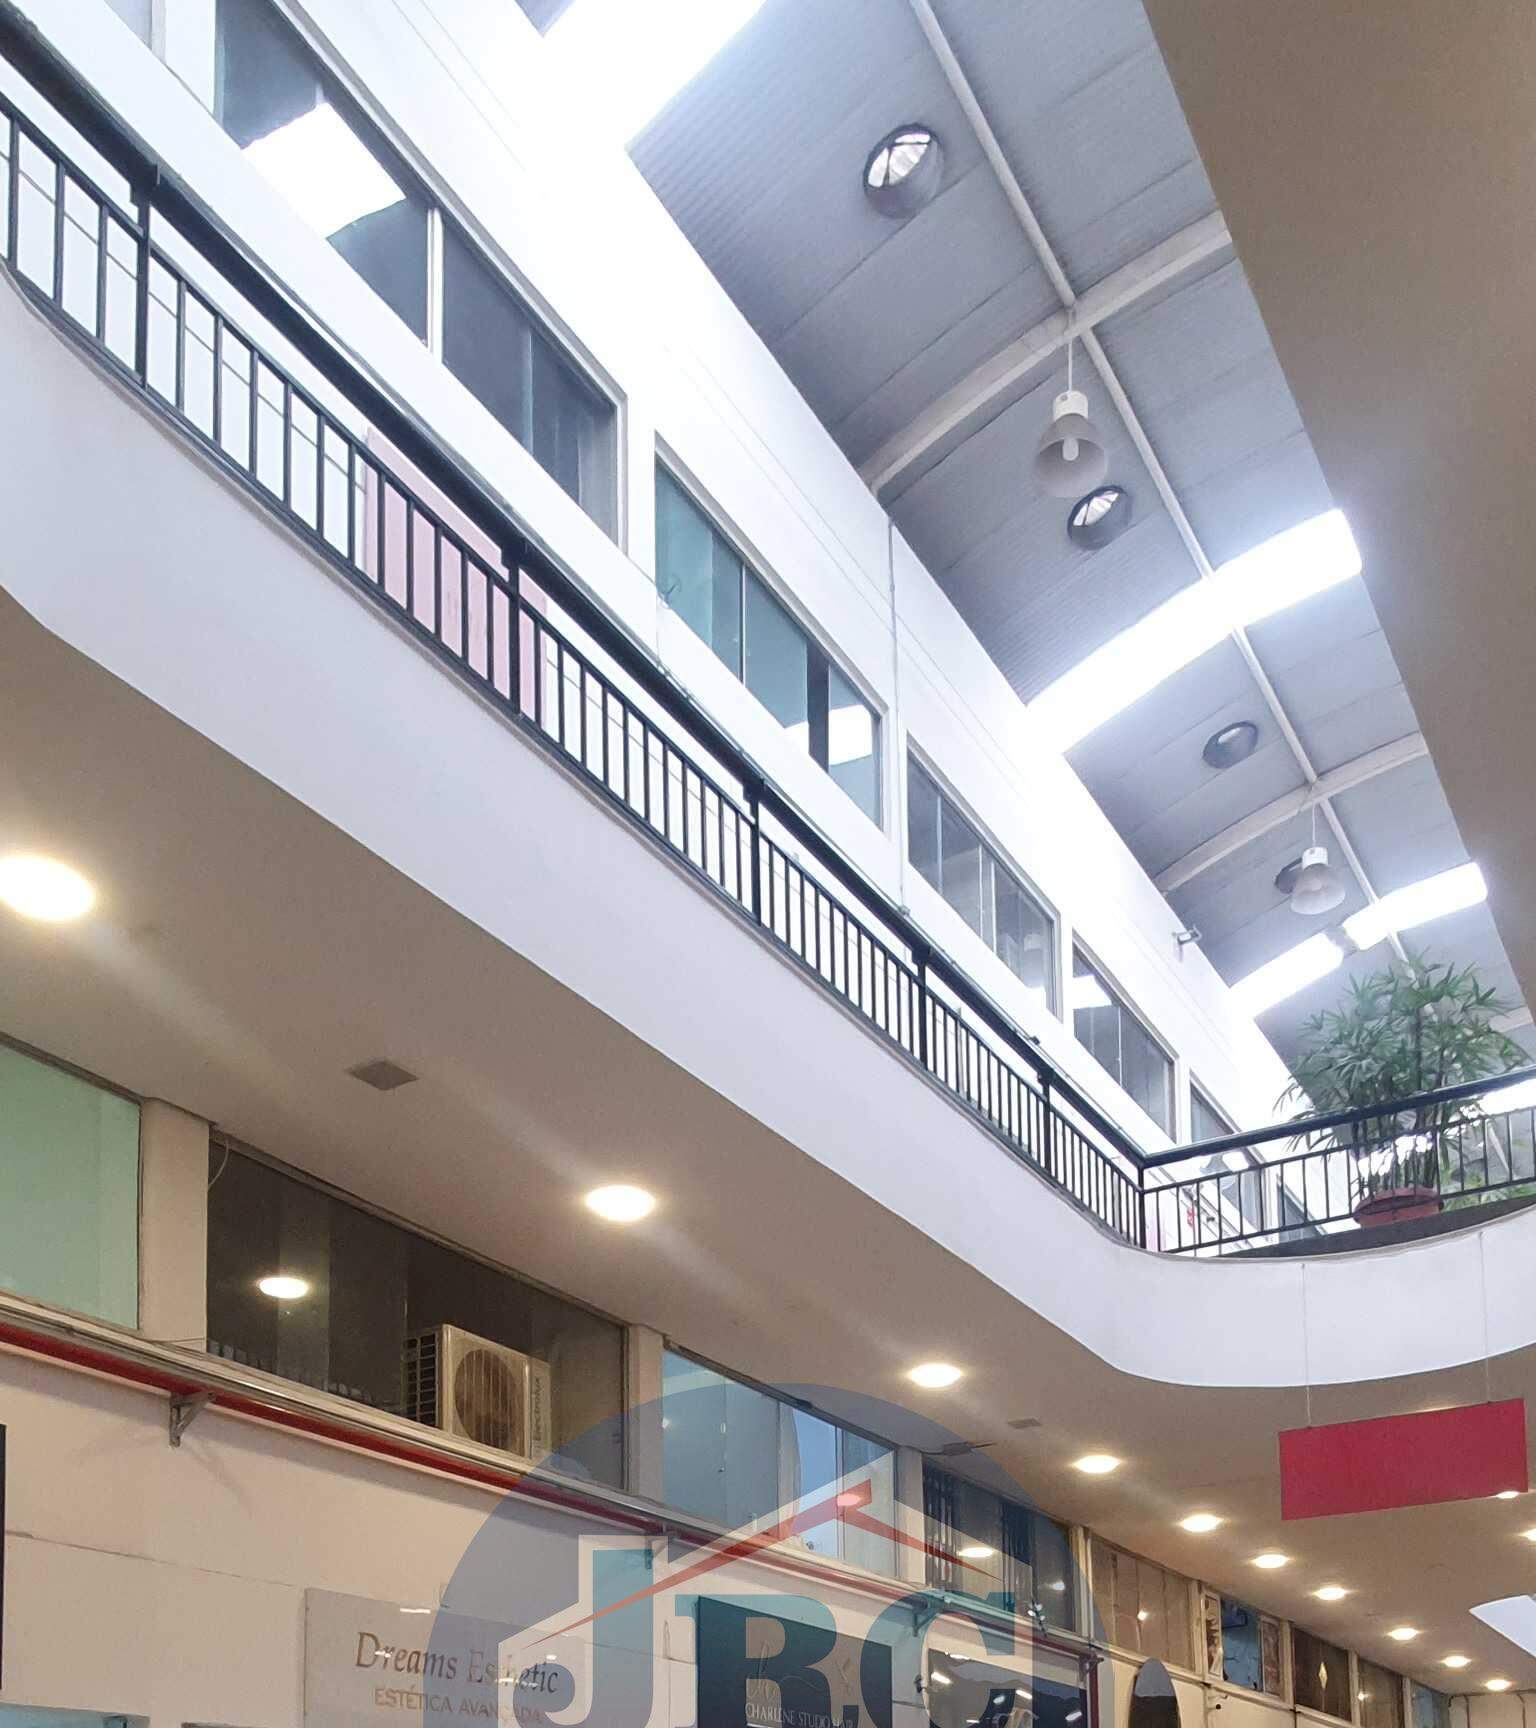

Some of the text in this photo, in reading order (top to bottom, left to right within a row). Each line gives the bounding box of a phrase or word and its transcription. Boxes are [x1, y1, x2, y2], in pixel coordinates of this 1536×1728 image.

[355, 1631, 559, 1693] Dreams Eshetic
[374, 1684, 453, 1713] ESTÉTICA
[745, 1702, 796, 1726] CHARLENE
